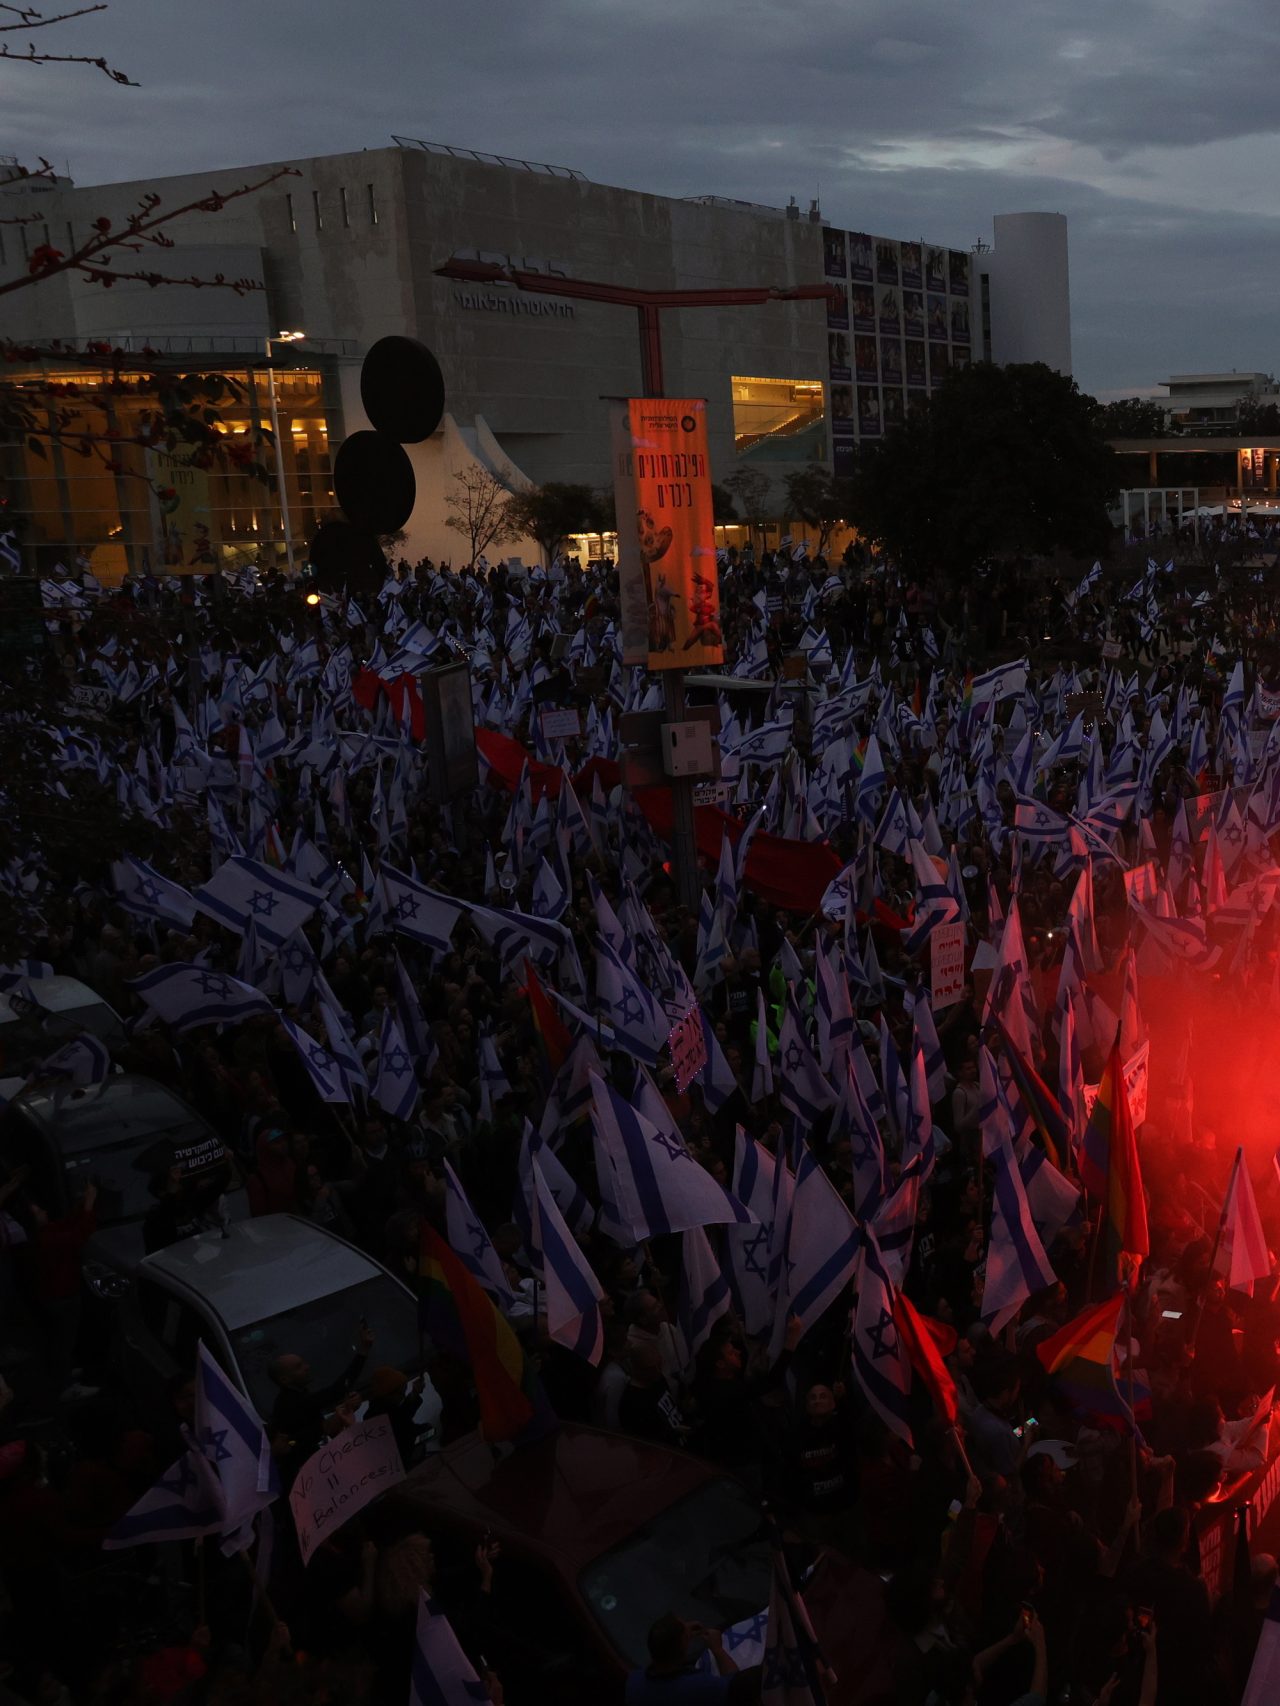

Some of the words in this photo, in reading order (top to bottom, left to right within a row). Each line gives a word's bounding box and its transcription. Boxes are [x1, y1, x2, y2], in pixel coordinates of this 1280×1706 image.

[639, 454, 705, 478] הפילהרמונית
[657, 483, 692, 508] לילדים
[188, 1152, 213, 1168] כיבוש
[319, 1425, 388, 1475] Checks
[313, 1457, 401, 1530] Balances!!
